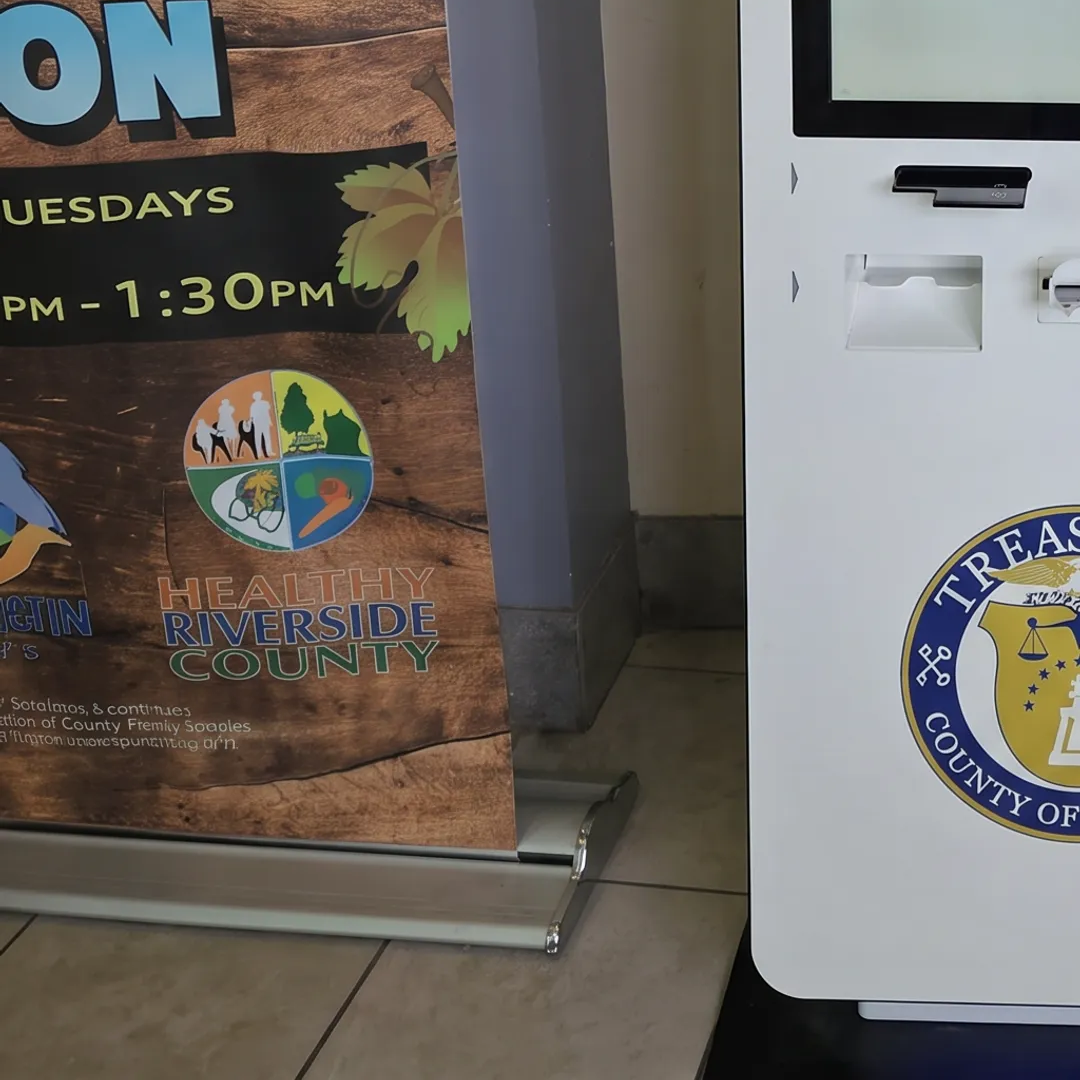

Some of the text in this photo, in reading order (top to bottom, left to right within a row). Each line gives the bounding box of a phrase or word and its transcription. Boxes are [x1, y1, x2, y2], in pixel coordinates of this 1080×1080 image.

[157, 567, 435, 610] HEALTHY
[161, 601, 438, 647] RIVERSIDE
[168, 640, 440, 682] COUNTY
[62, 717, 121, 734] County
[924, 711, 1033, 817] COUNTY
[1036, 802, 1080, 827] OF
